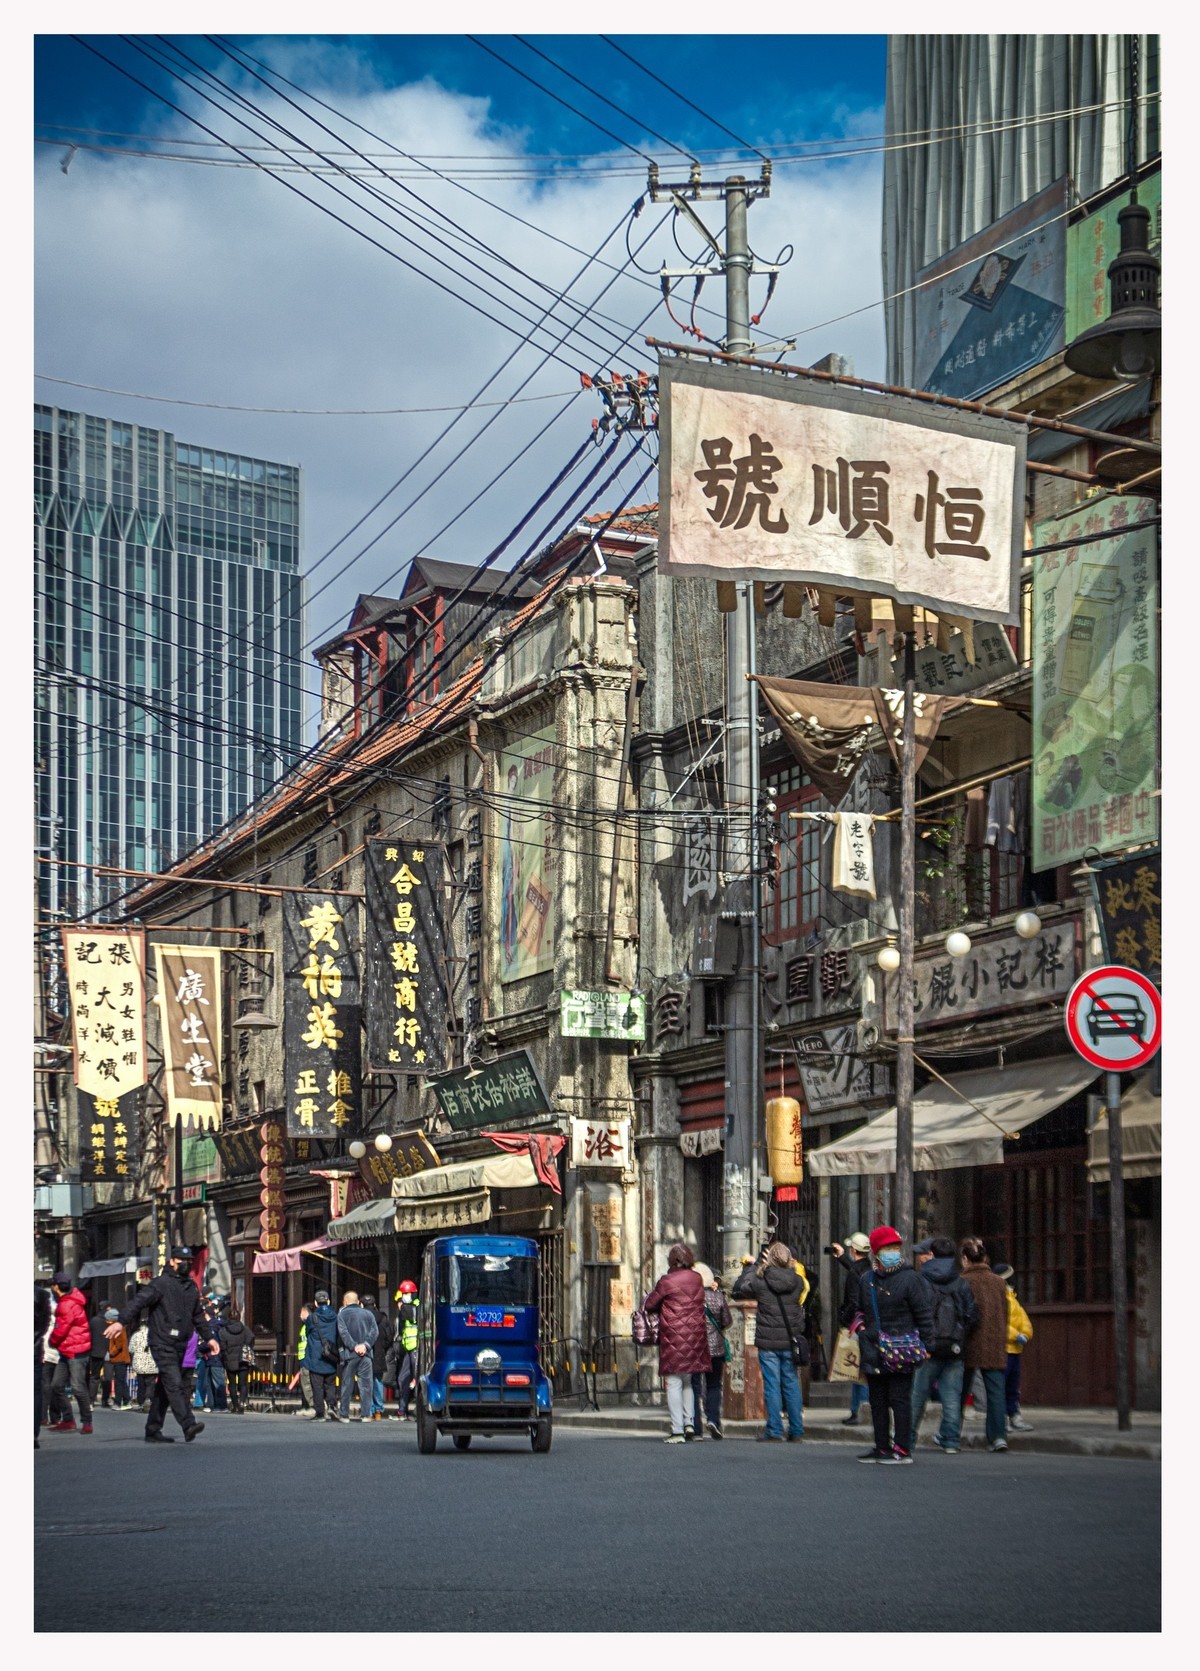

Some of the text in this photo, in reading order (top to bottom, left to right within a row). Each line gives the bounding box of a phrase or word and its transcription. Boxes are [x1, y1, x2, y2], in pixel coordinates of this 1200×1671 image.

[694, 432, 992, 562] 恒順號
[849, 820, 870, 882] 老字號
[74, 941, 132, 966] 張記
[390, 863, 421, 1048] 合昌號商行
[119, 981, 138, 1066] 男女鞋帽
[572, 990, 620, 1002] RADIOLAND
[94, 986, 120, 1083] 大減價
[175, 968, 213, 1087] 廣生堂
[797, 1040, 823, 1051] HERO
[294, 1070, 320, 1127] 正骨
[326, 1069, 353, 1128] 推拿
[585, 1126, 623, 1161] 浴
[477, 1311, 503, 1323] 32792
